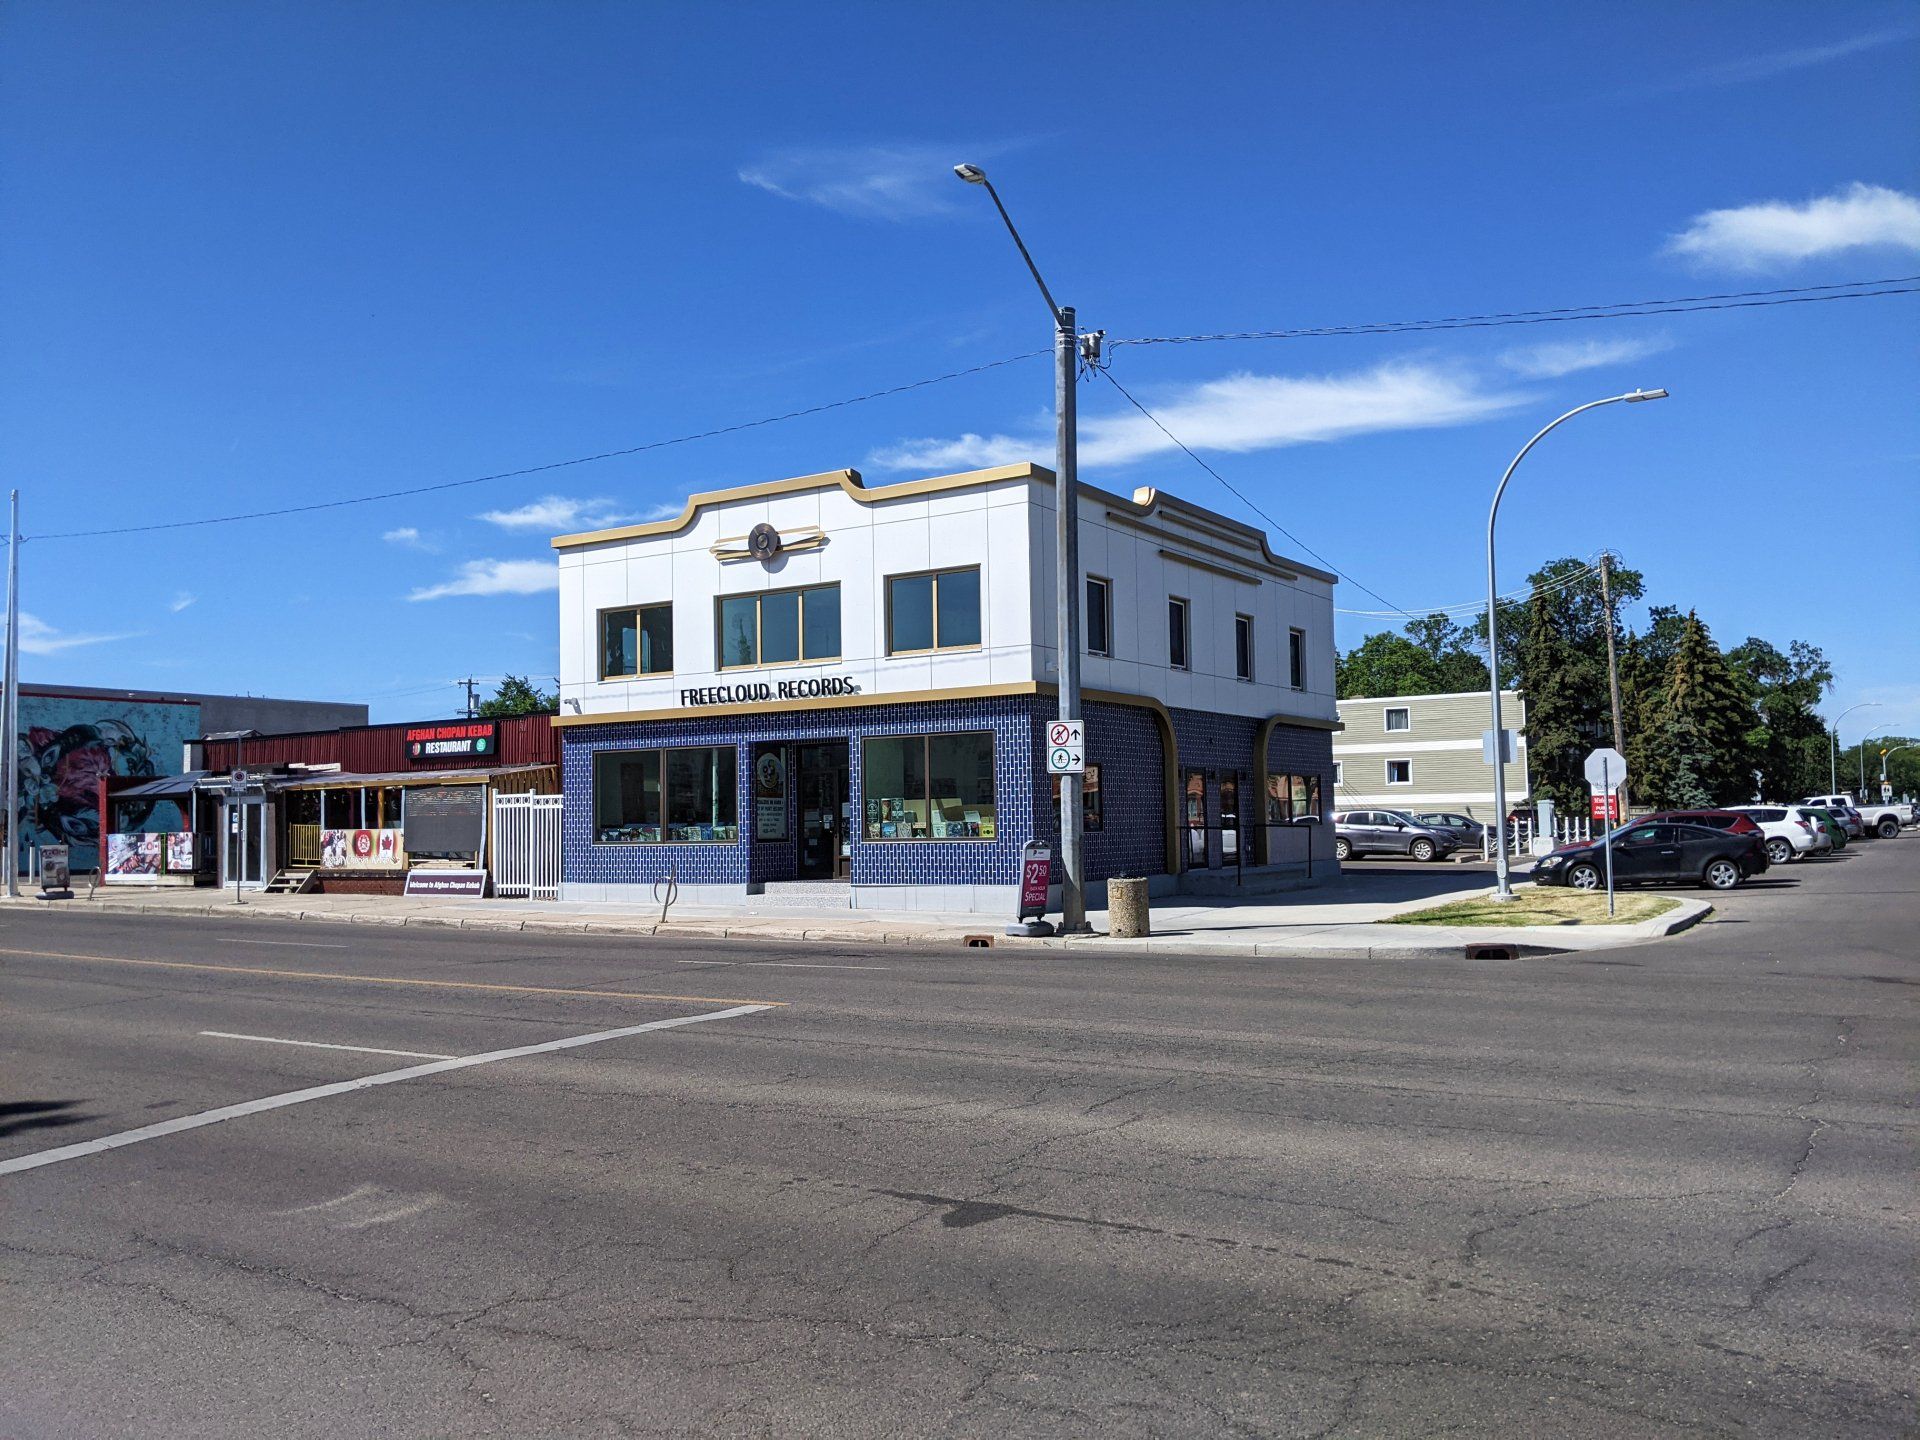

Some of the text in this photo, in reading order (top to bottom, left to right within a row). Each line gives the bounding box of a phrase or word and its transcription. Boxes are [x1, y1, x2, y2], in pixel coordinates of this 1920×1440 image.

[680, 676, 855, 706] FREECLOUD RECORDS
[407, 724, 493, 741] AFGHAN CHOPAN KEBAB
[426, 740, 472, 754] RESTAURANT
